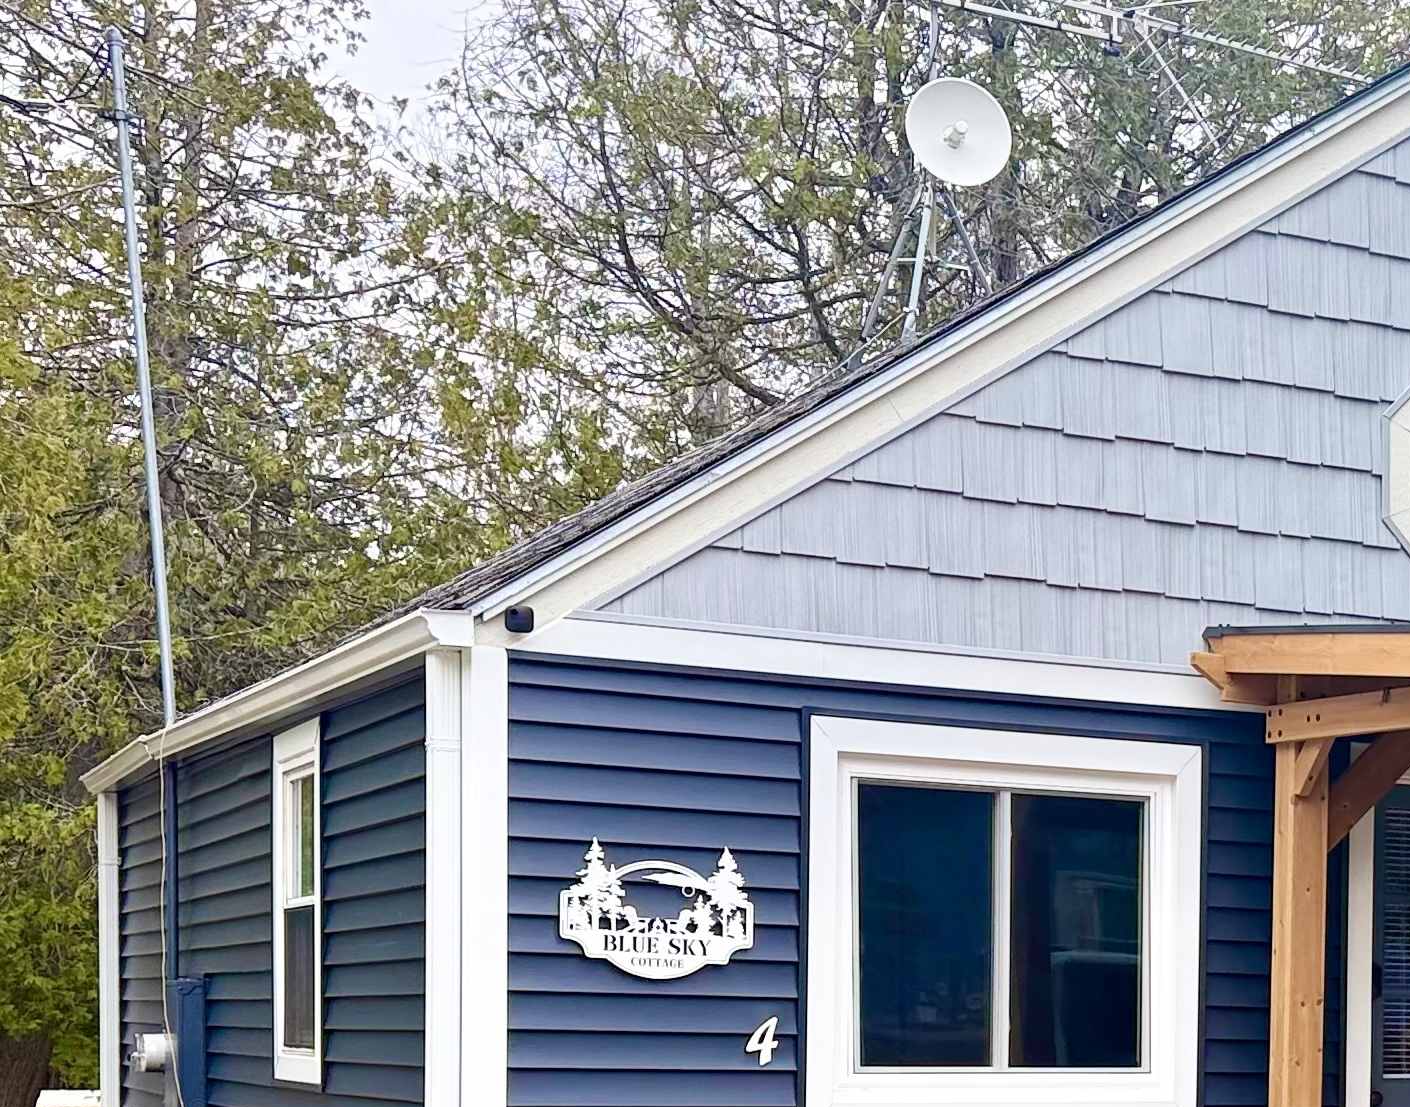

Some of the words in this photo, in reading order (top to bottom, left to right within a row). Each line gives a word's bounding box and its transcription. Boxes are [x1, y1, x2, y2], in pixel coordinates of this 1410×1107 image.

[604, 934, 659, 954] BLUE
[667, 938, 711, 957] SKY
[631, 957, 684, 969] COTTAGE
[744, 1016, 779, 1066] 4
